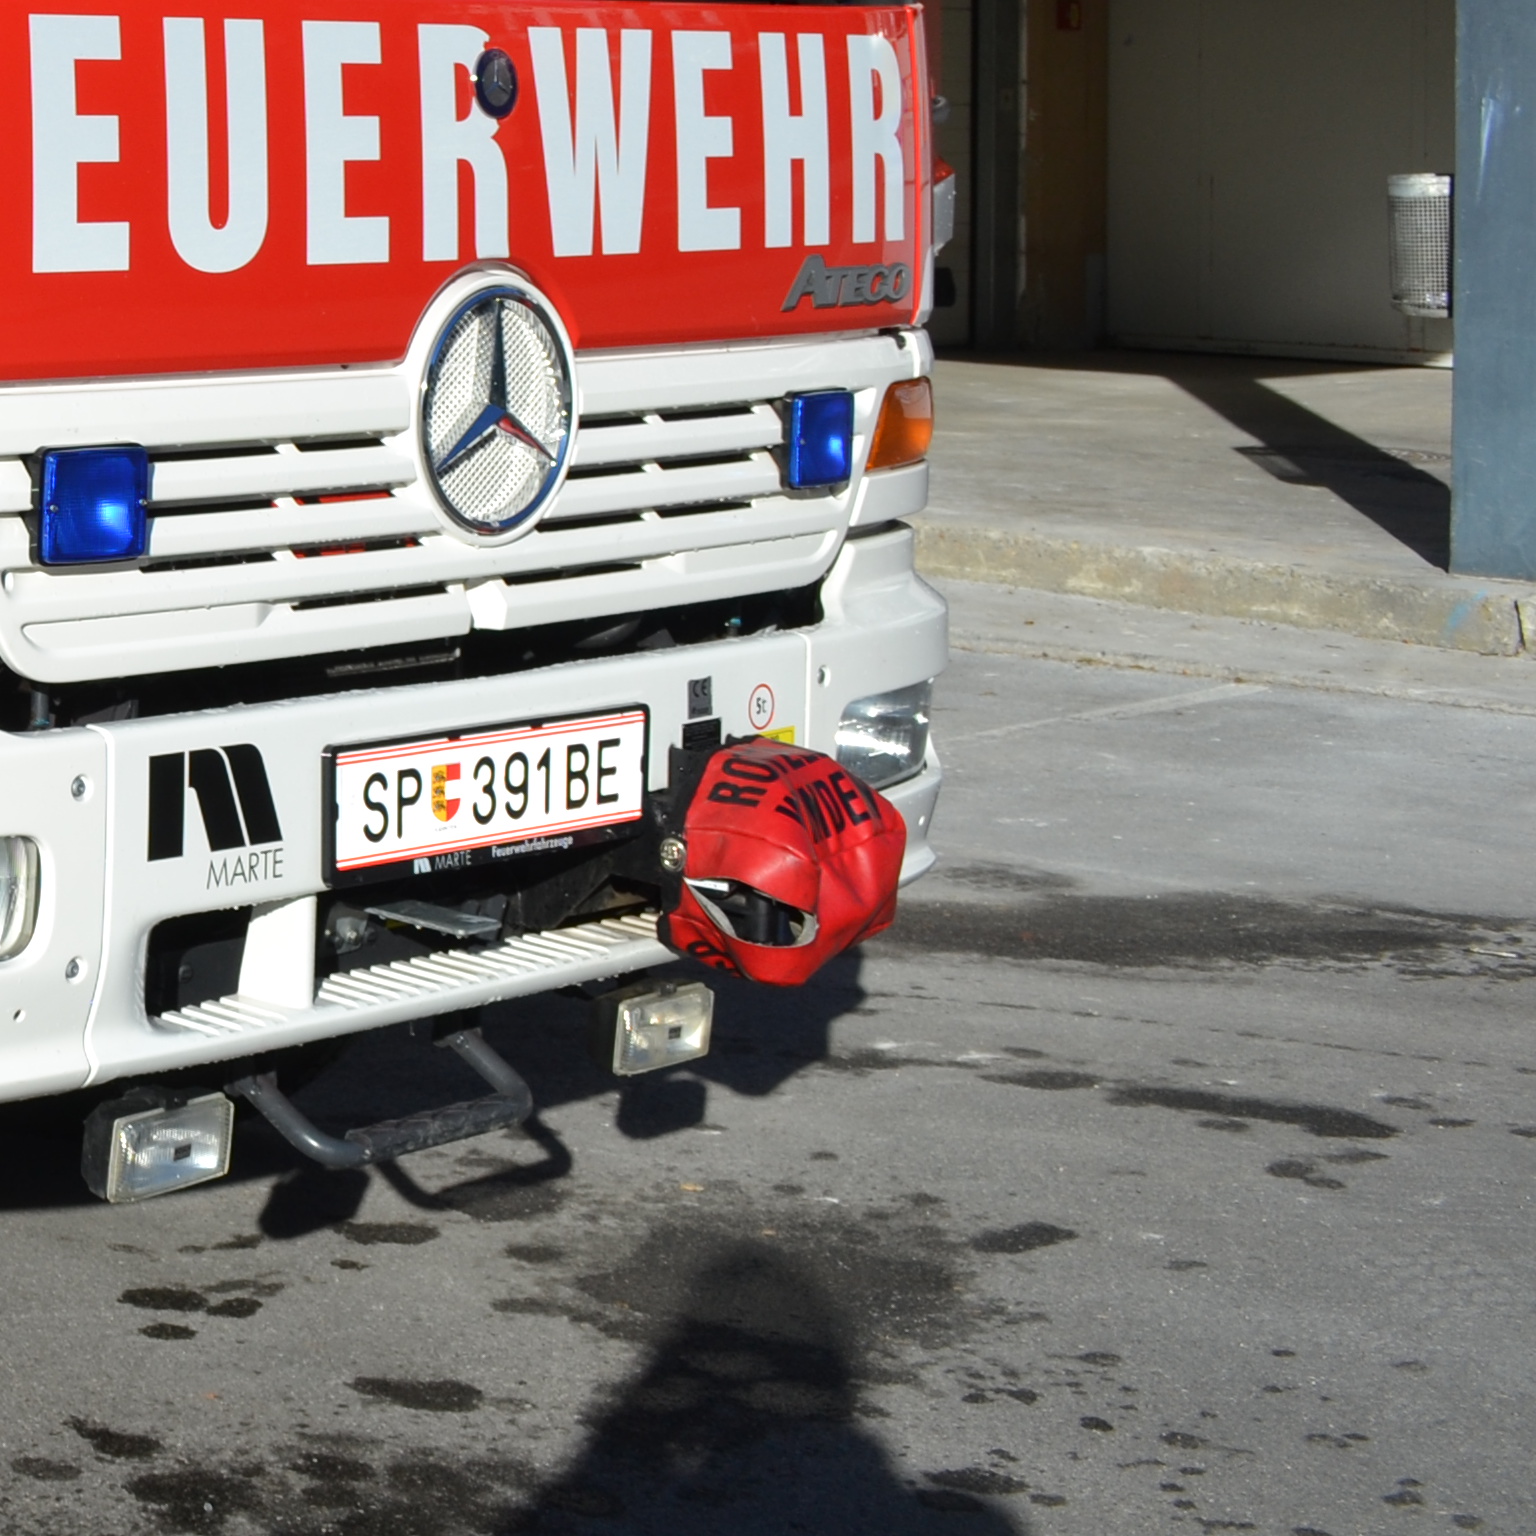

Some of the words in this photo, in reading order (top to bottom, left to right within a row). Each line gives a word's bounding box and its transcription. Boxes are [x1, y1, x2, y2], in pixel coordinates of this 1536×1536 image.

[363, 768, 423, 843] SP
[207, 848, 283, 890] MARTE
[434, 849, 472, 871] MARTE
[491, 835, 574, 859] Feuerwehrfahrzeuge
